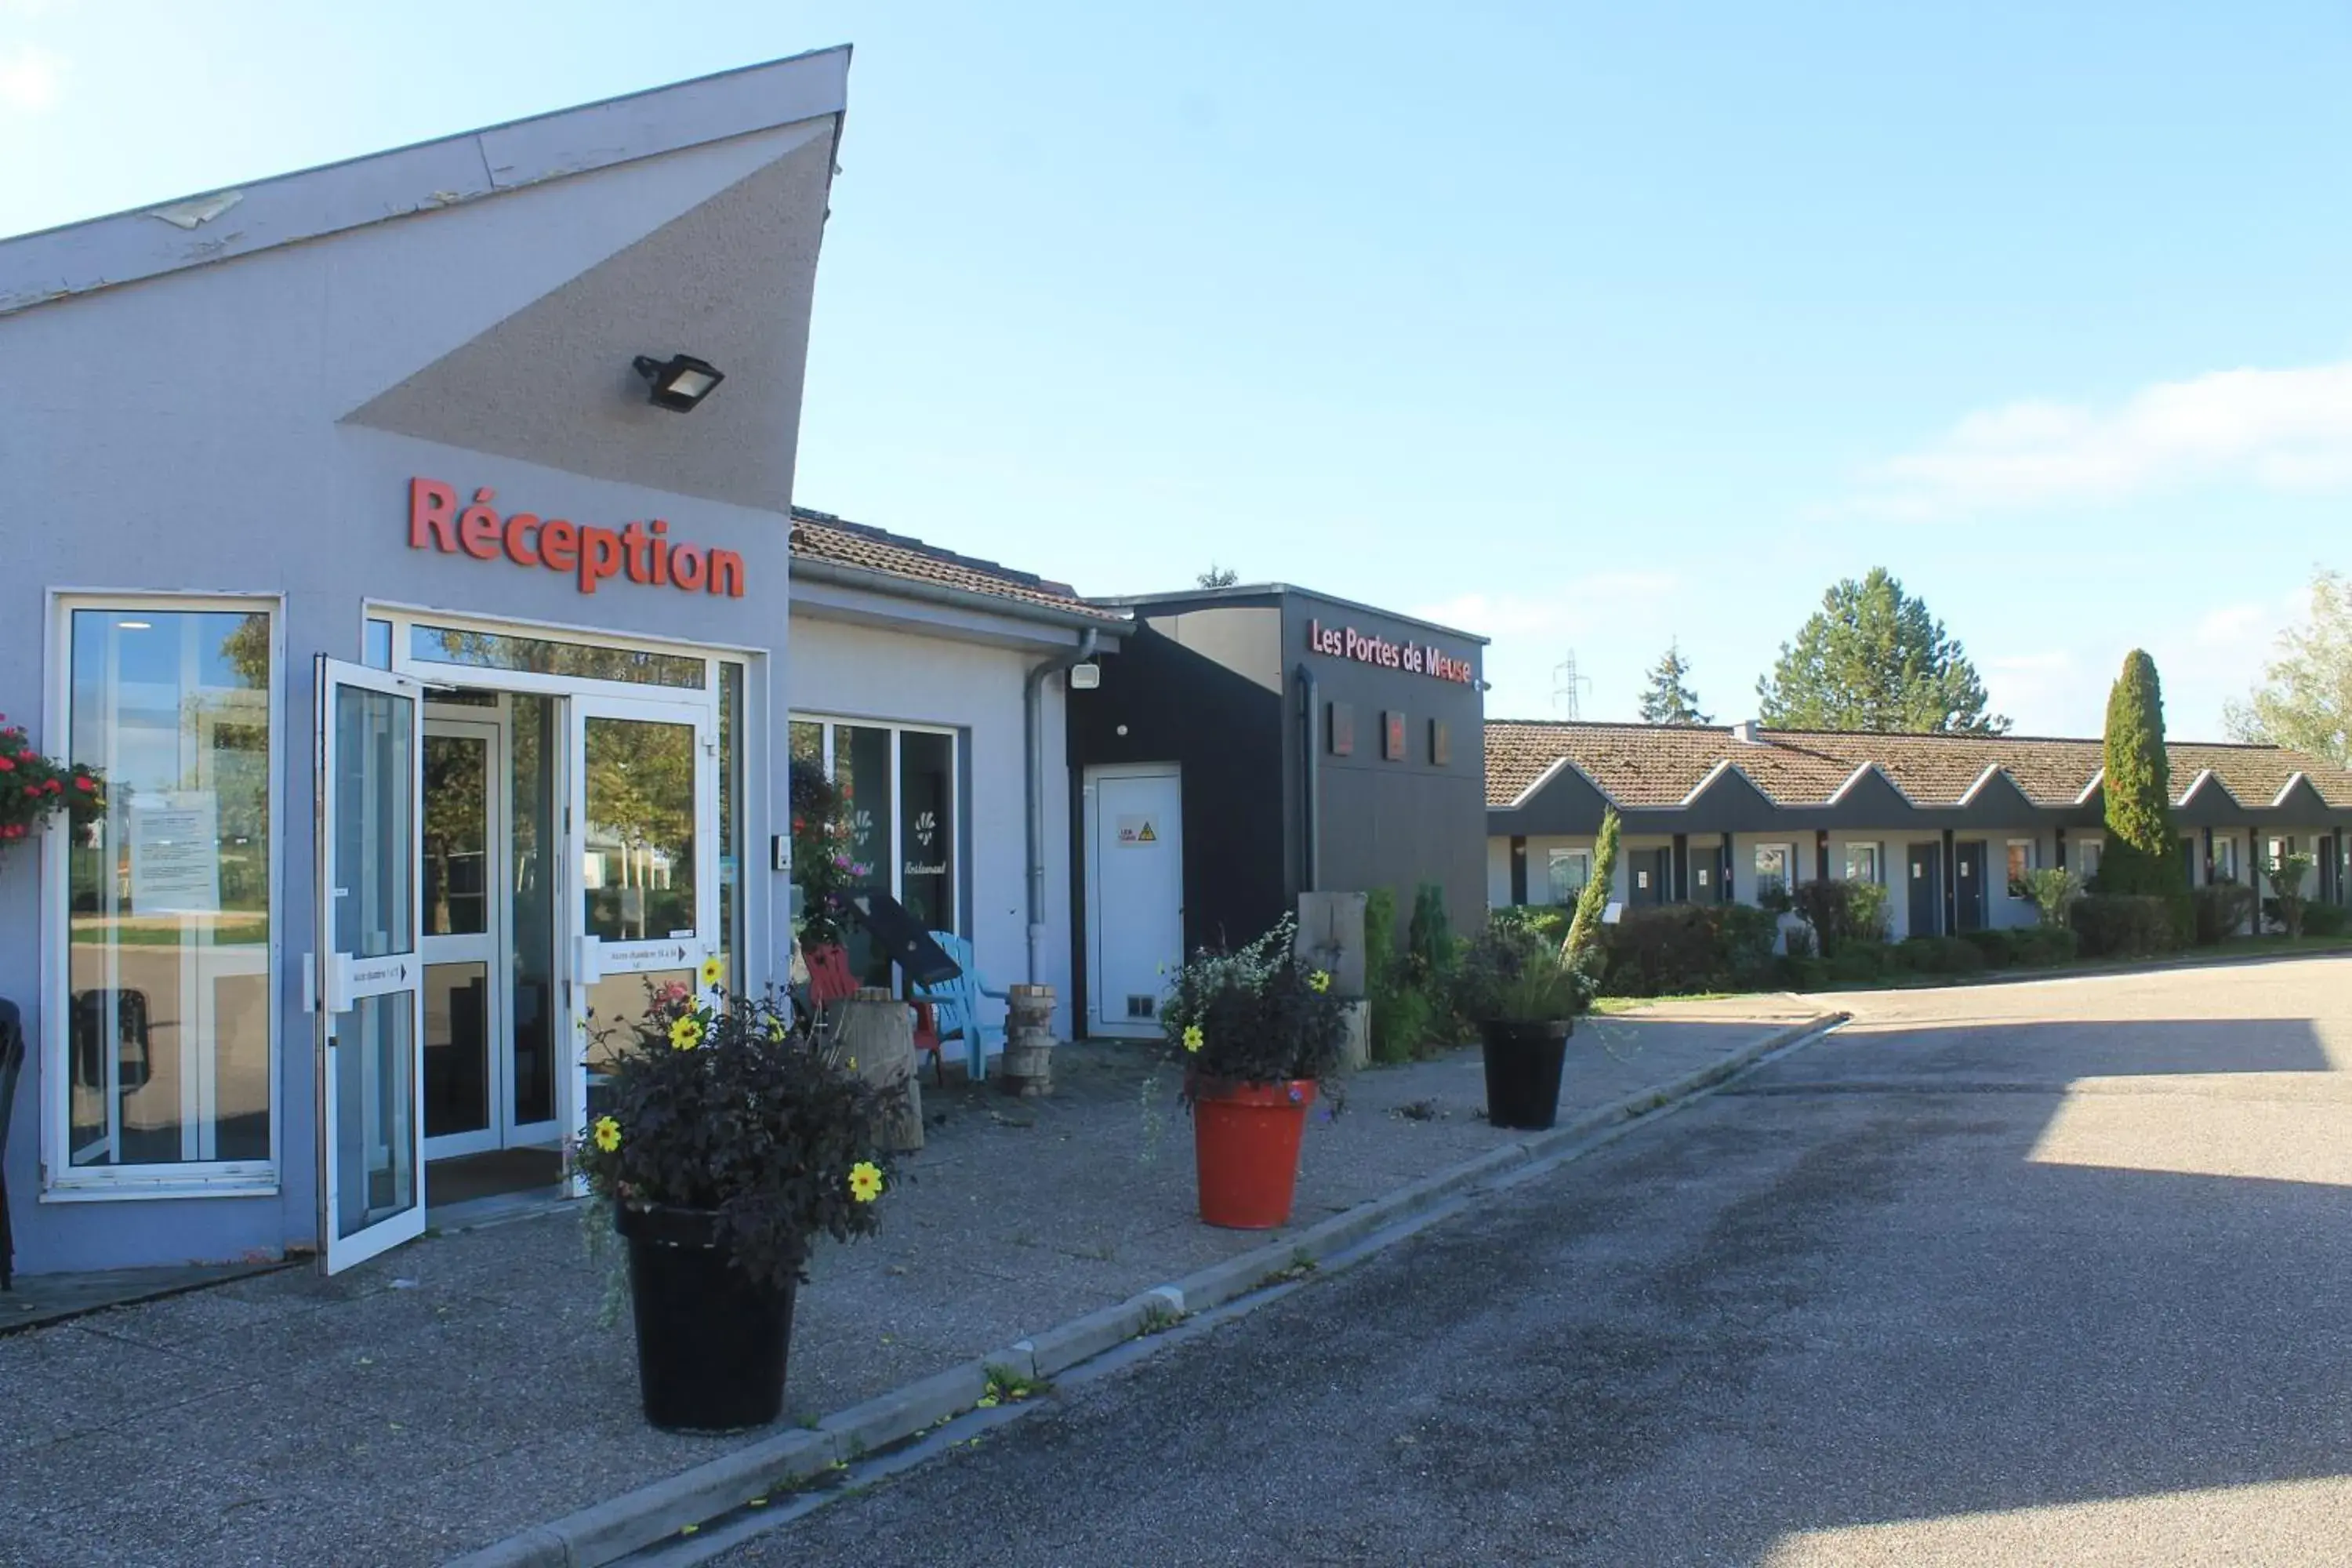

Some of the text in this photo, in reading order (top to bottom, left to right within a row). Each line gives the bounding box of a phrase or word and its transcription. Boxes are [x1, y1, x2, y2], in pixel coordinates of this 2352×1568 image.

[409, 477, 744, 597] Réception
[1308, 618, 1472, 683] Les Portes de Meuse
